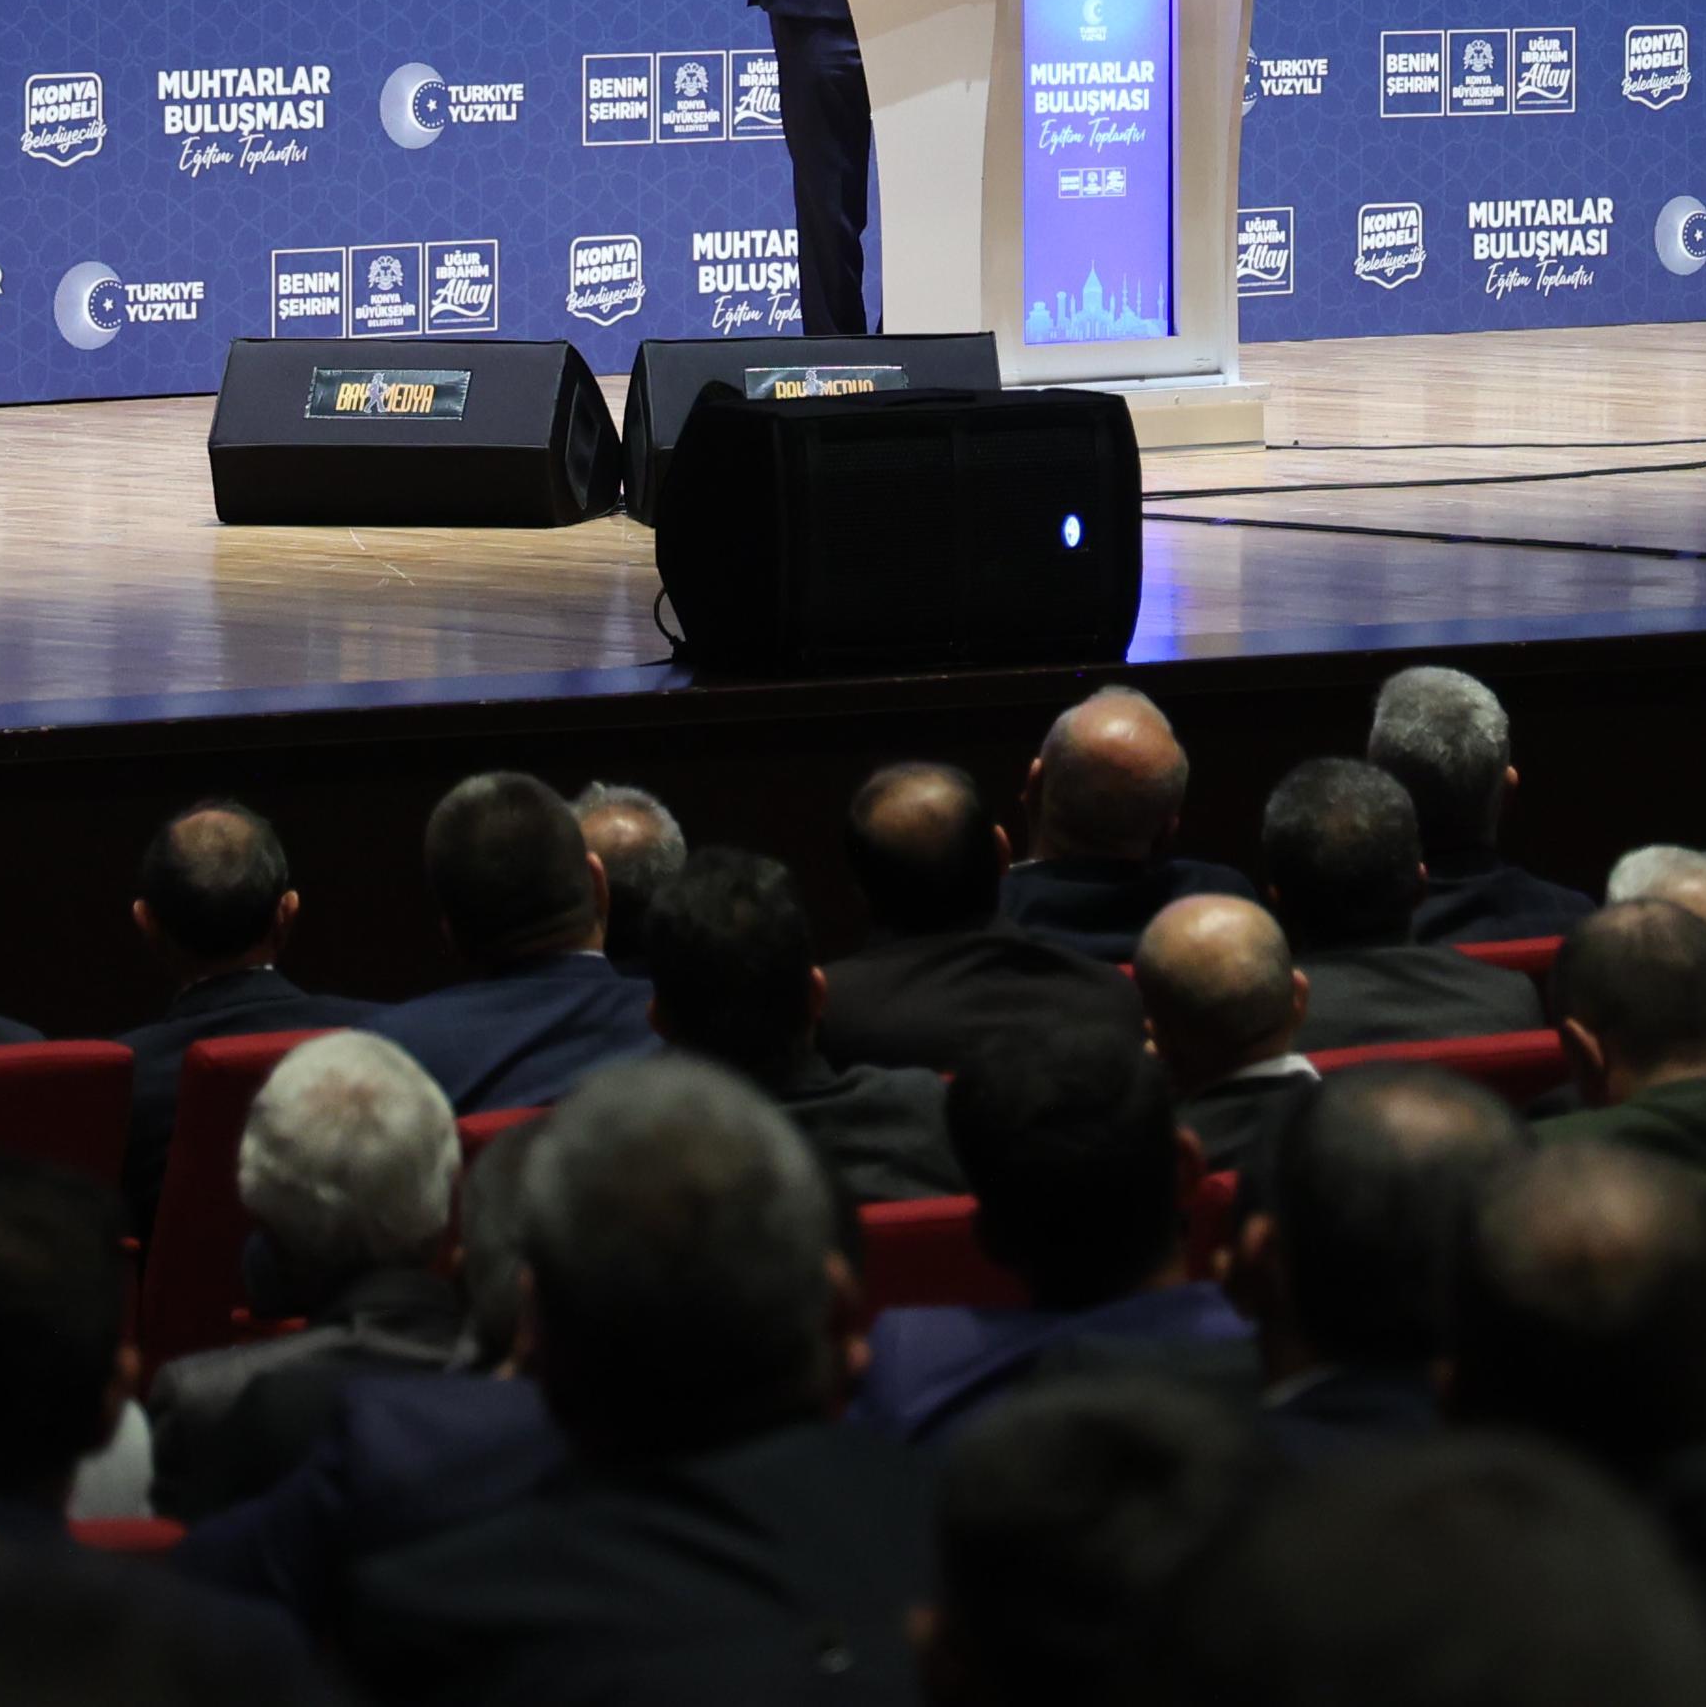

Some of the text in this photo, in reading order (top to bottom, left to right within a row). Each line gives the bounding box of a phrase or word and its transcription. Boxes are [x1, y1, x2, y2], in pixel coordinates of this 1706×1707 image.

[1631, 32, 1684, 54] KONYA
[1031, 60, 1154, 86] MUHTARLAR
[1629, 50, 1684, 71] MODELİ
[159, 66, 330, 99] MUHTARLAR
[1622, 67, 1691, 97] Belediyecilik
[1035, 89, 1150, 116] BULUŞMASI
[165, 100, 323, 136] BULUŞMASI
[180, 136, 233, 177] Eğitim
[1469, 198, 1613, 228] MUHTARLAR
[1474, 229, 1607, 262] BULUŞMASI
[1486, 262, 1531, 300] Eğitim
[336, 383, 369, 411] BAY
